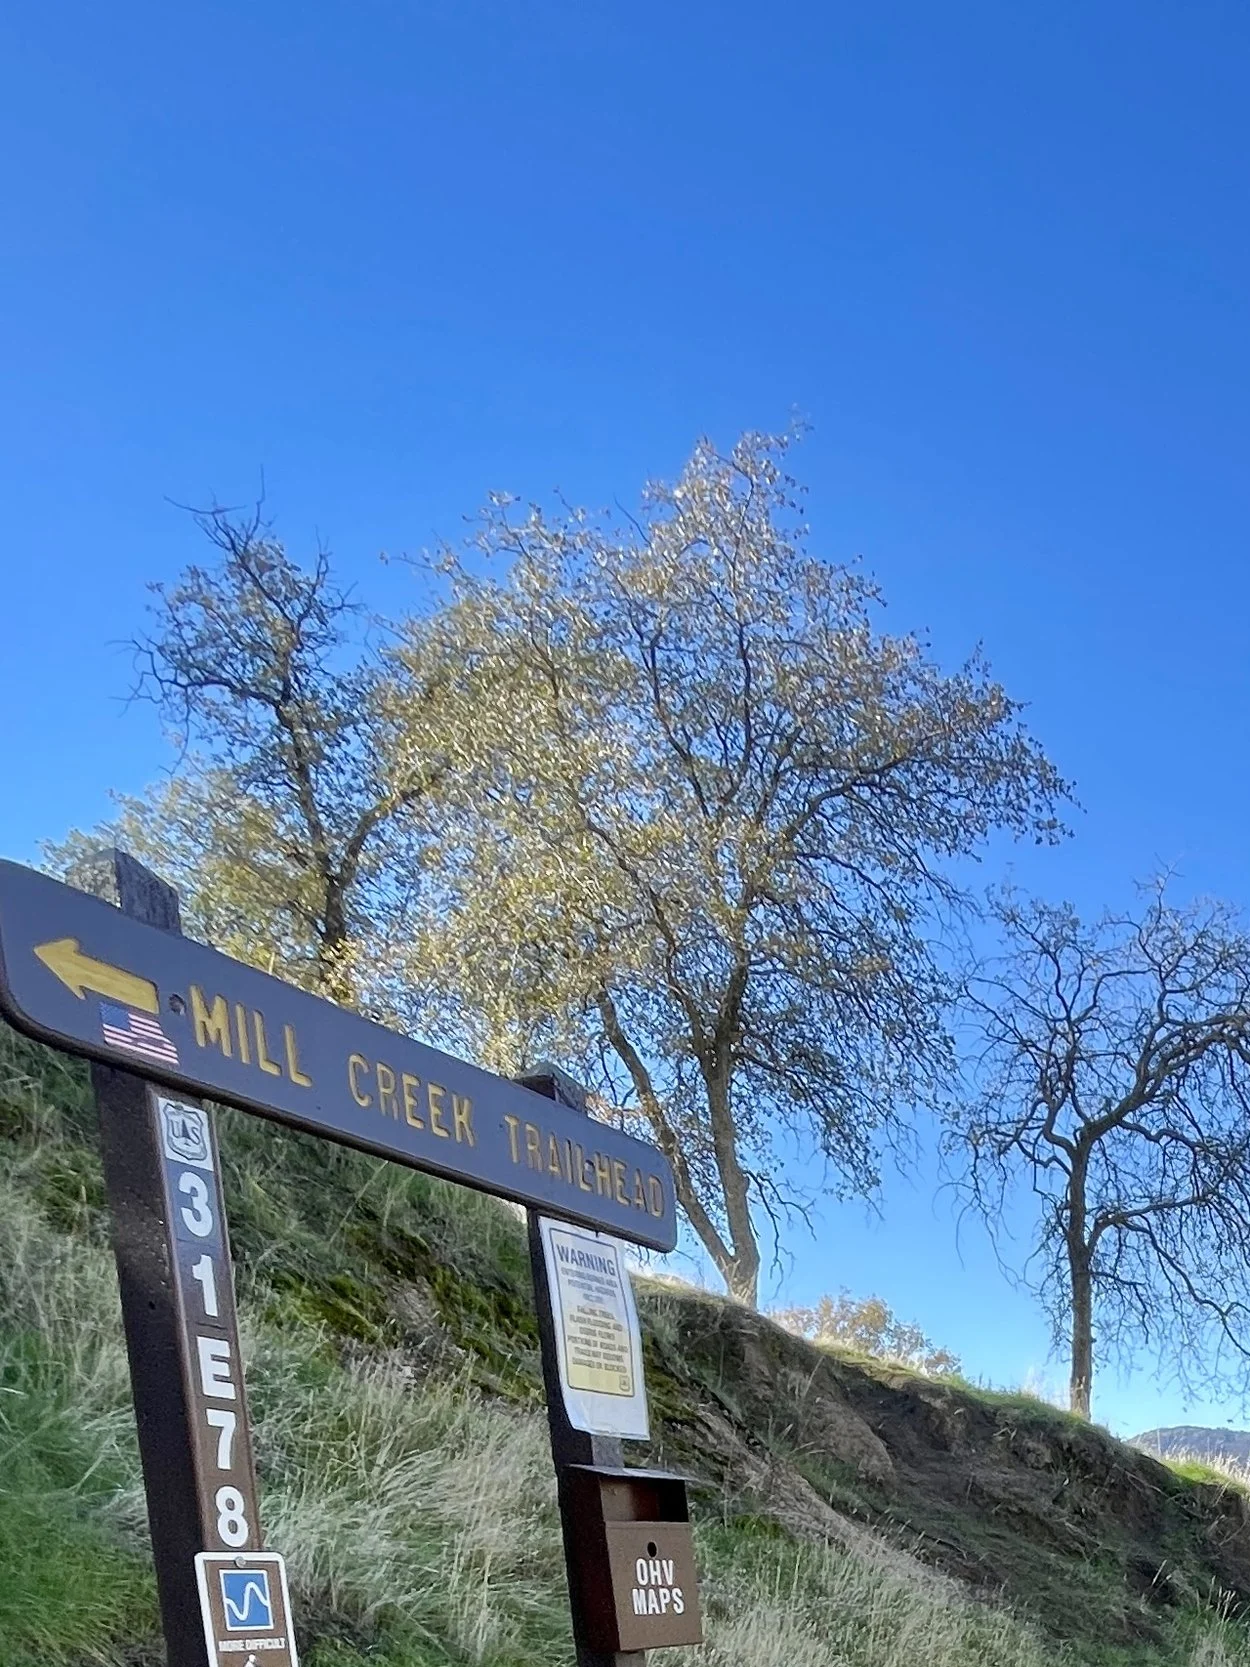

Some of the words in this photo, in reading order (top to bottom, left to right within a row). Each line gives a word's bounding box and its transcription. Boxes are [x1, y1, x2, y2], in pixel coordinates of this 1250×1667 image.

[190, 984, 313, 1088] MILL
[348, 1052, 476, 1148] CREEK
[504, 1114, 665, 1218] TRAILHEAD
[556, 1243, 616, 1277] WARNING
[636, 1558, 675, 1586] OHV
[632, 1588, 685, 1615] MAPS
